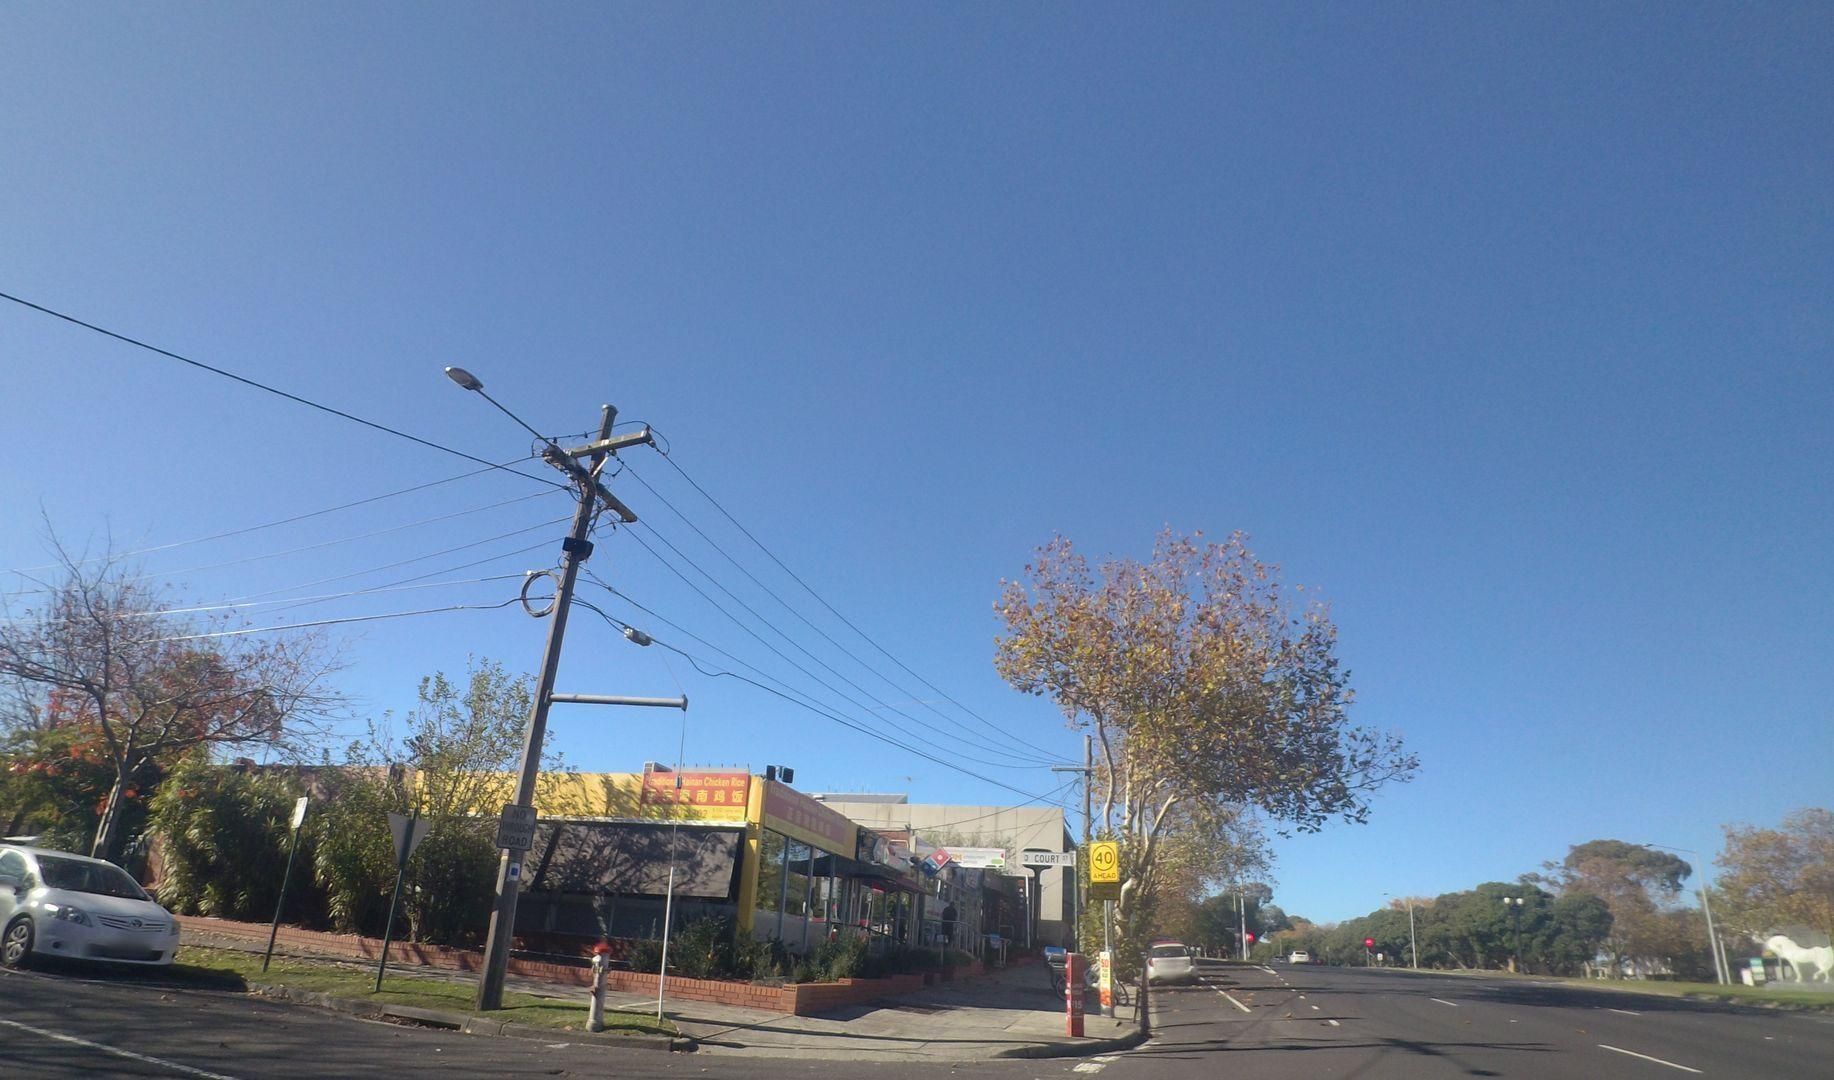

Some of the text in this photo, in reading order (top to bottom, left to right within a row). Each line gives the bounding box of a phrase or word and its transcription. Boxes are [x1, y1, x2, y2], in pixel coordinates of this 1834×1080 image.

[703, 777, 730, 787] Chicken
[730, 777, 745, 787] Rice
[512, 808, 526, 820] NO
[503, 834, 527, 847] ROAD
[1034, 854, 1060, 863] COURT
[1095, 852, 1112, 864] 40
